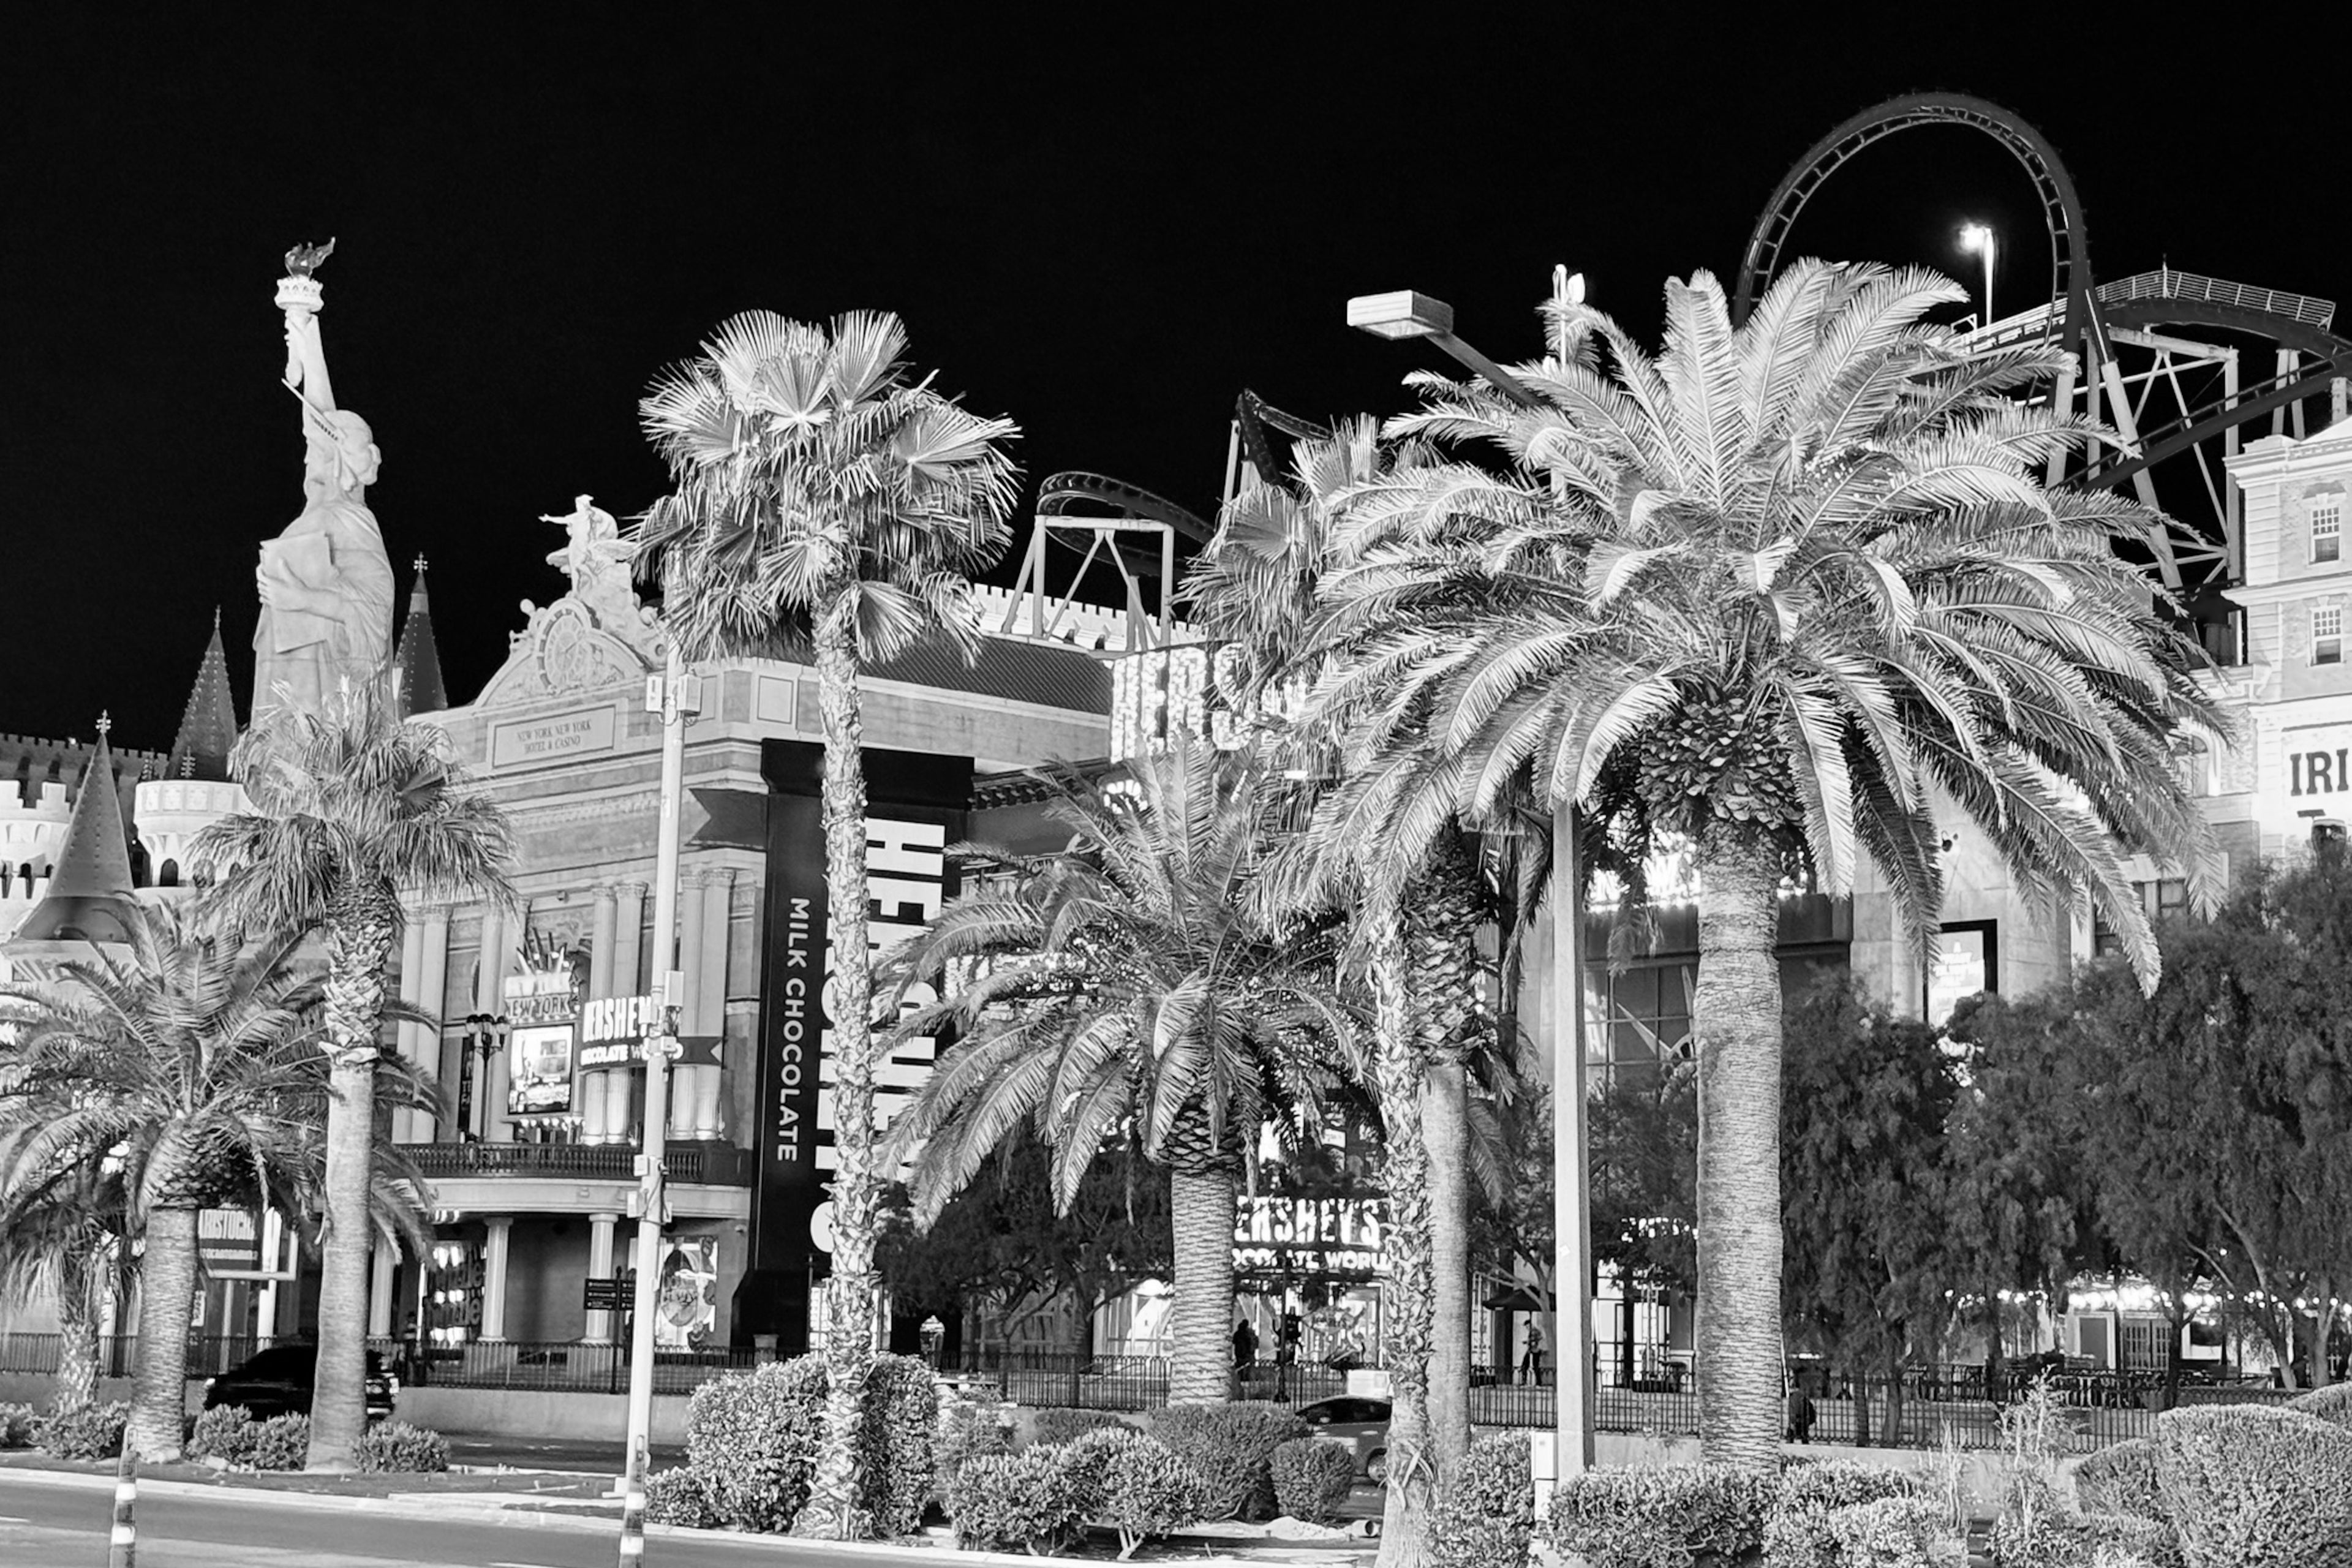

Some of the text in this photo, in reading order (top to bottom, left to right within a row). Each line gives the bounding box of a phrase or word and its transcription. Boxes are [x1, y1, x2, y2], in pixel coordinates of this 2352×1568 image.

[535, 993, 571, 1017] YORK
[777, 897, 810, 1162] MILK CHOCOLATE
[631, 1041, 684, 1061] WOD
[810, 817, 945, 1253] HESHE
[1234, 1195, 1381, 1250] ERSHEY'S
